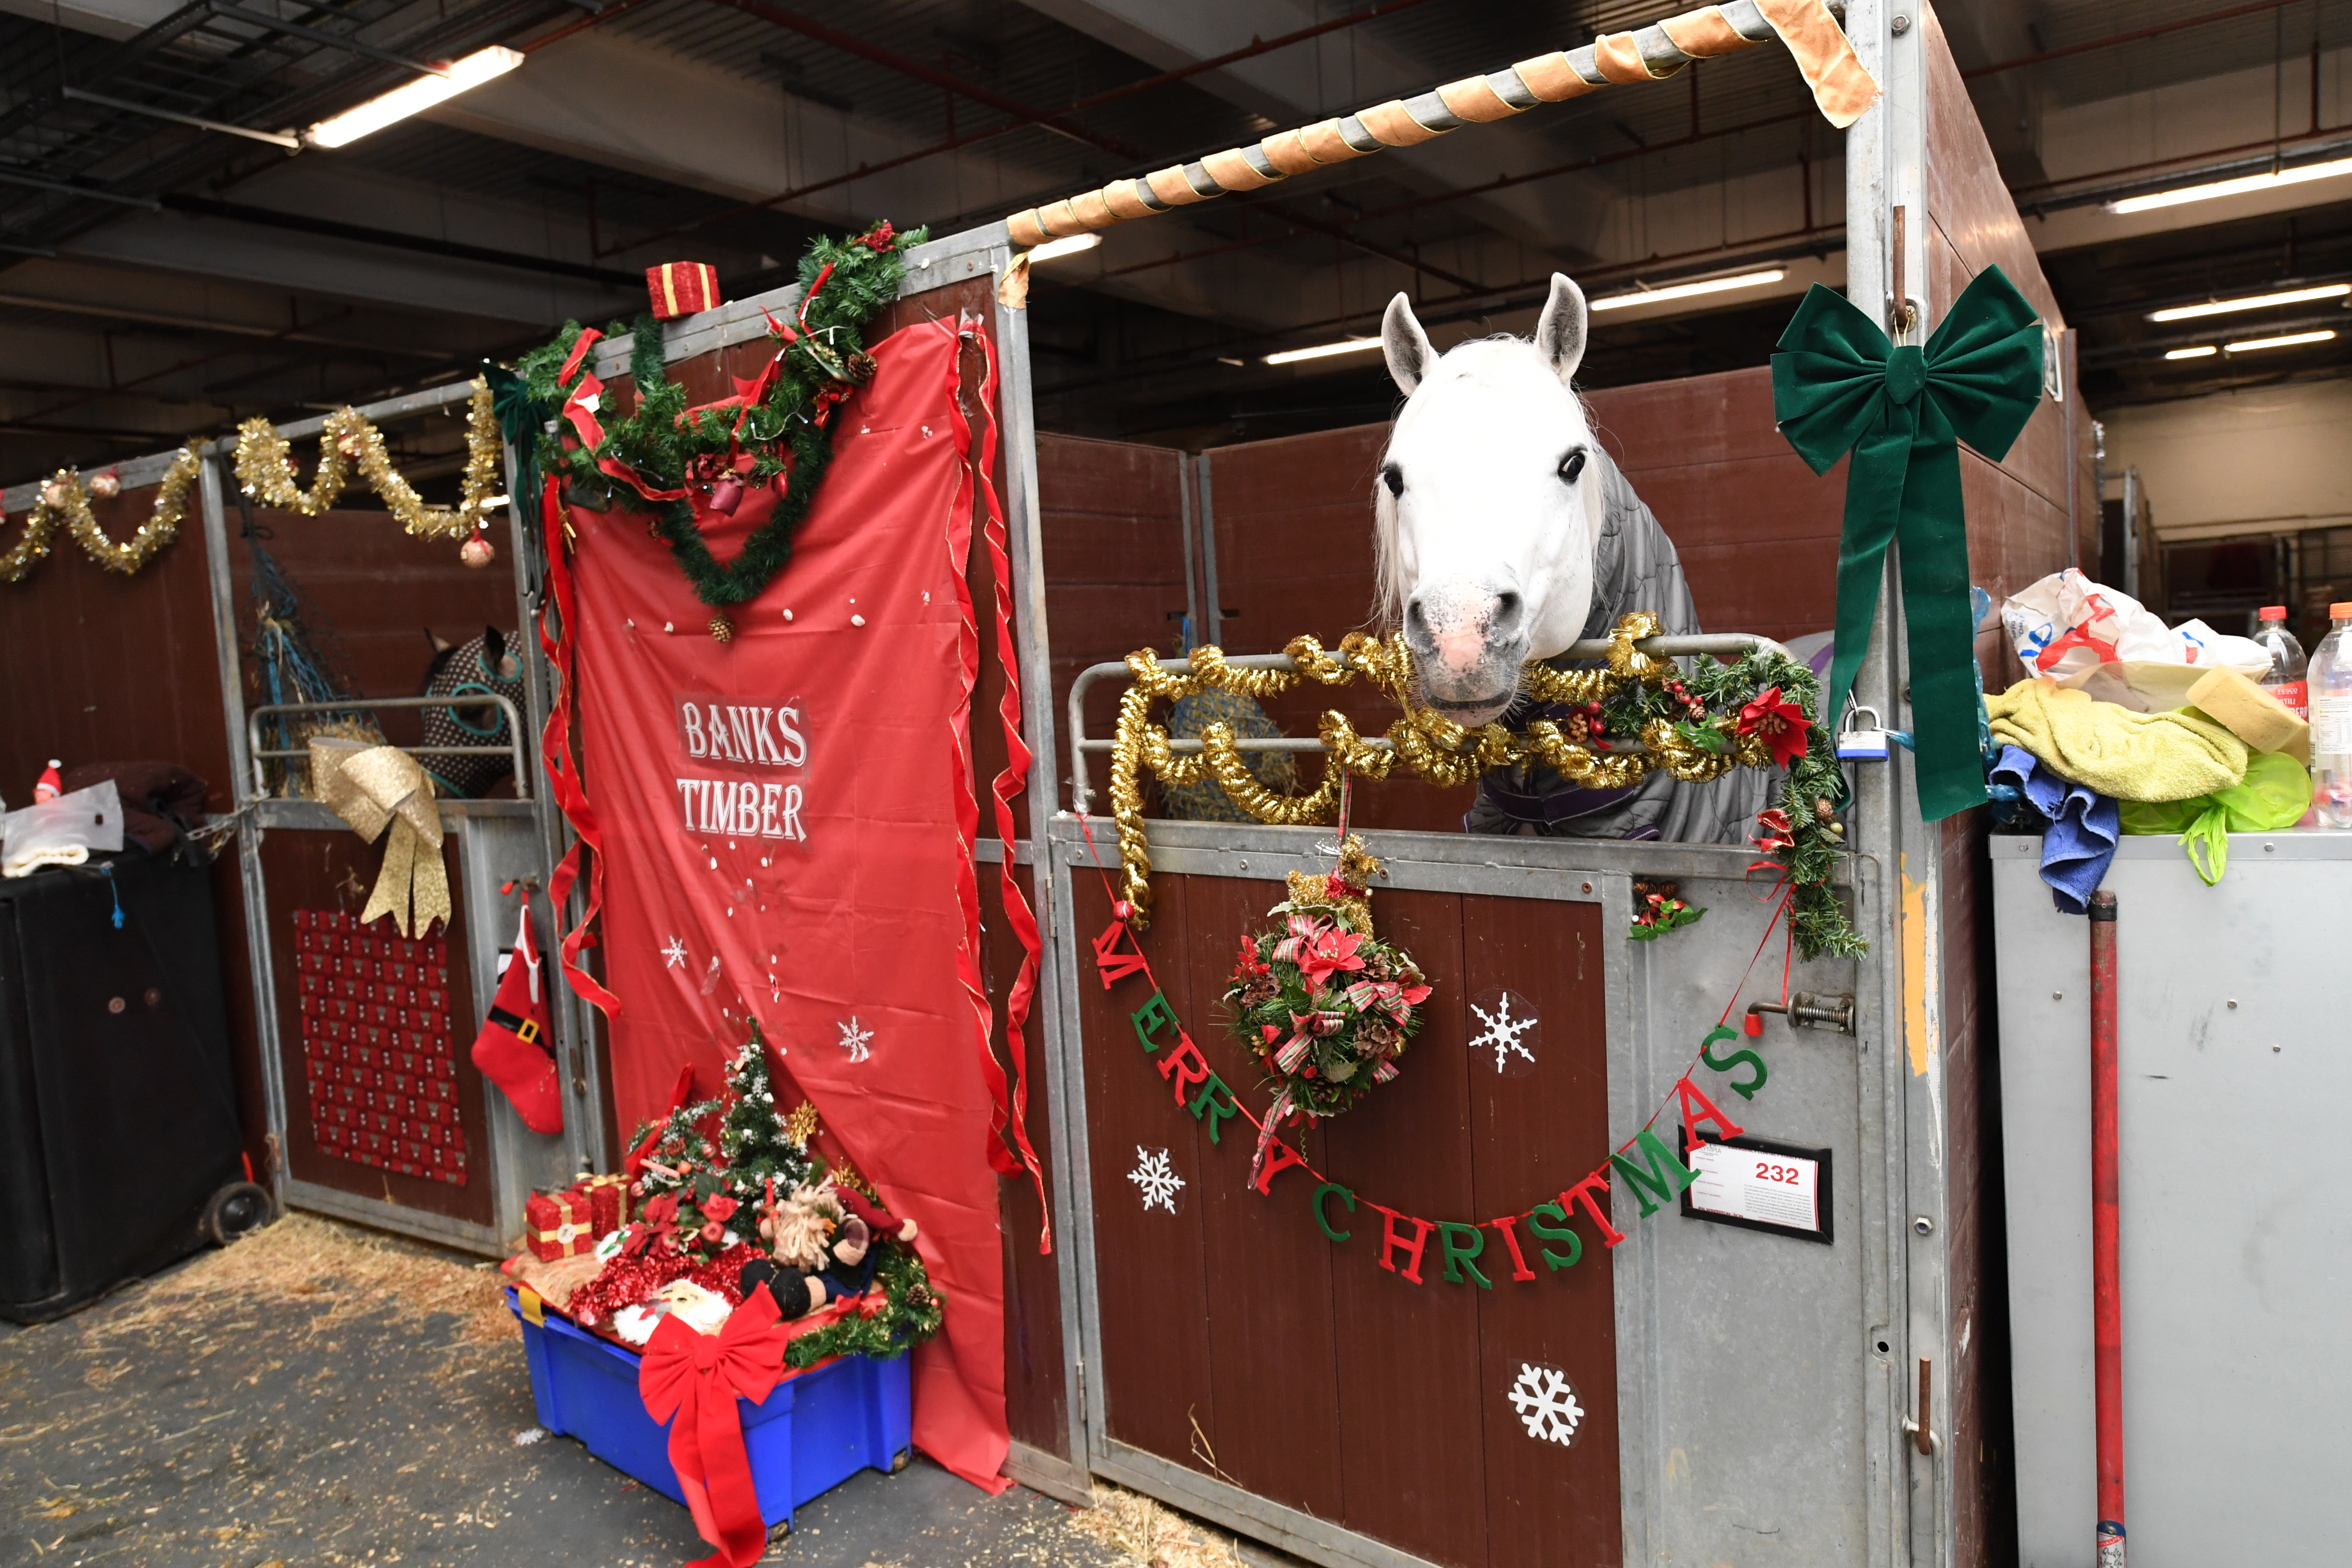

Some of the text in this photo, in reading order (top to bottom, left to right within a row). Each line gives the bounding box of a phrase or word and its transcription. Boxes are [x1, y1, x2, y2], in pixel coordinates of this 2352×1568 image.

[682, 702, 807, 767] BANKS
[676, 778, 807, 843] TIMBER
[1092, 921, 1767, 1290] MERRY CHRISTMAS
[1698, 1146, 1722, 1154] LYMPIA
[1756, 1162, 1799, 1185] 232
